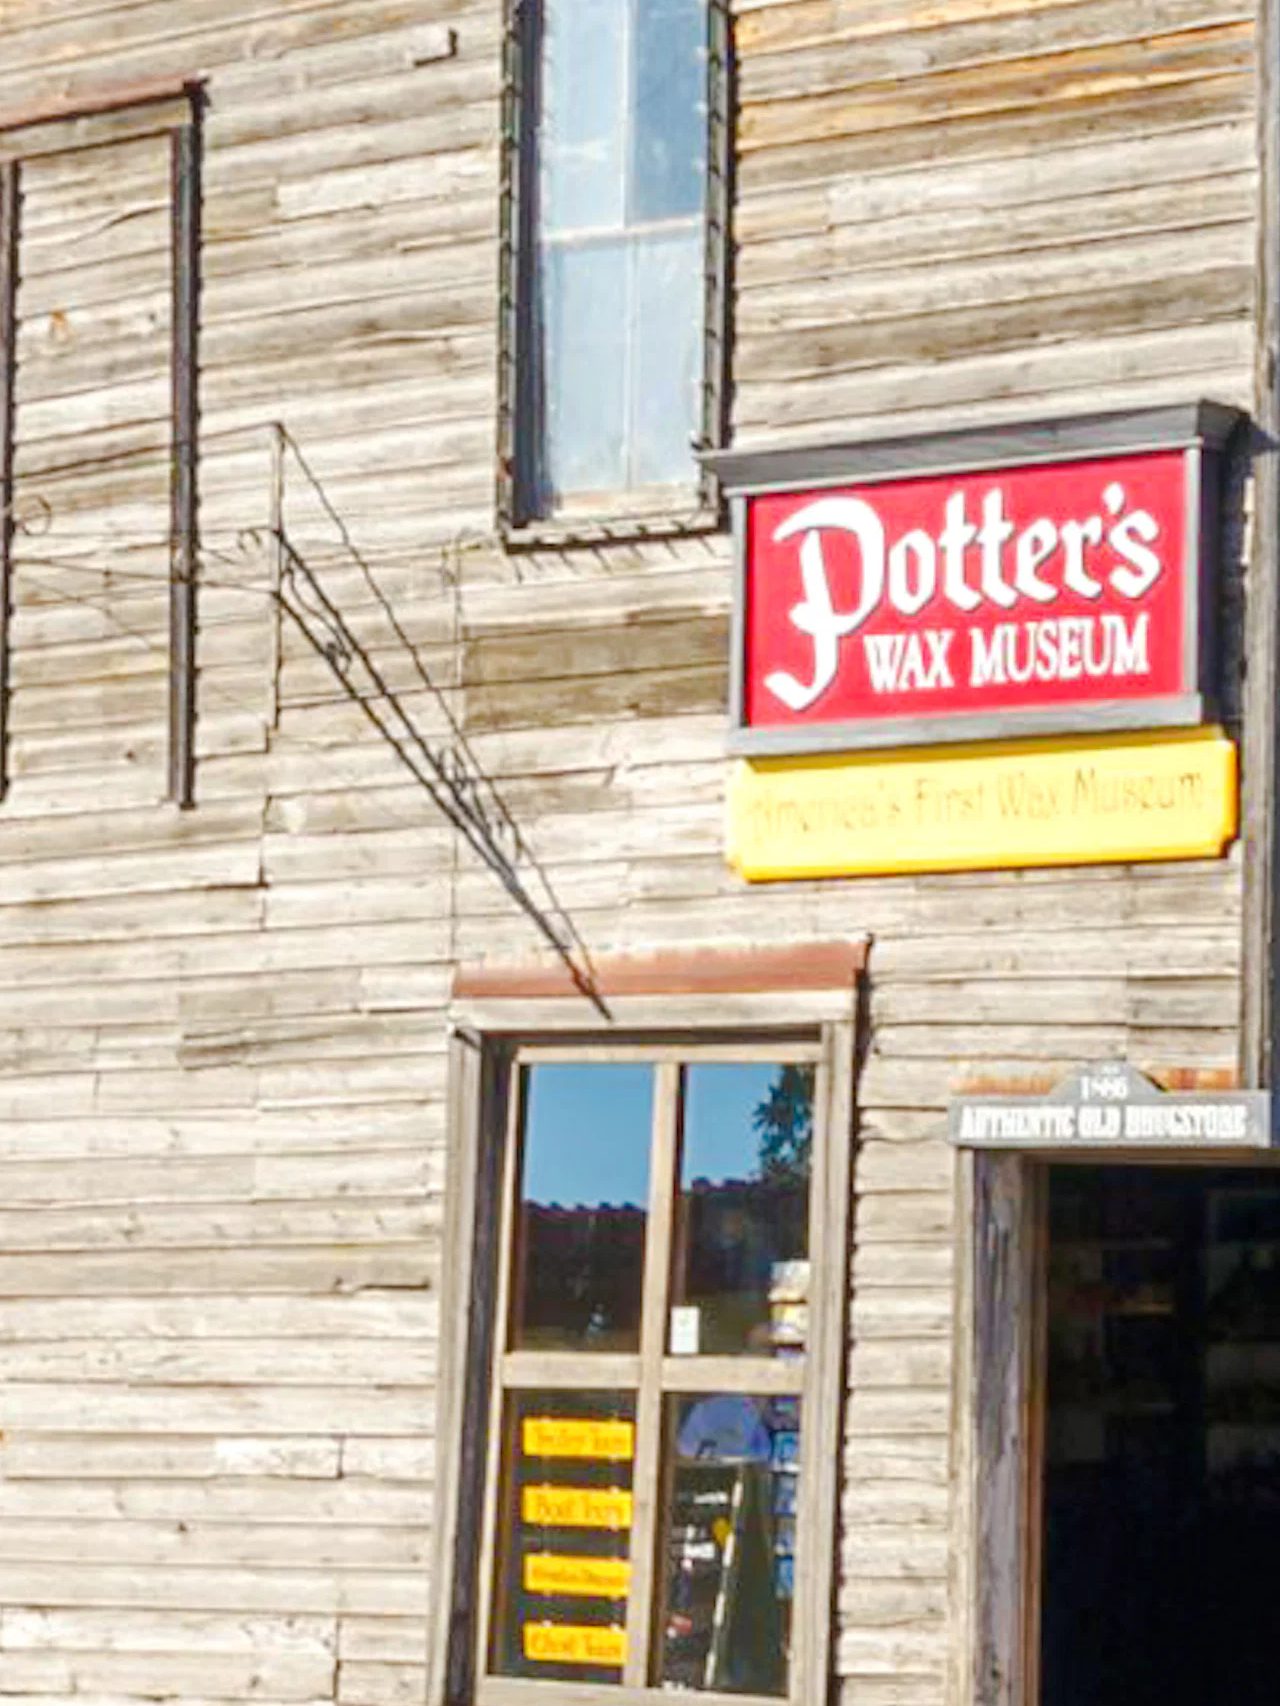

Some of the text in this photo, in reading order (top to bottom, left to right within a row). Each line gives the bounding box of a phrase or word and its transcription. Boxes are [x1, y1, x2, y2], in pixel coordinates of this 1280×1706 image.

[764, 482, 1164, 712] Potter's
[863, 612, 1150, 694] WAX MUSEUM
[914, 775, 985, 826] First
[998, 770, 1058, 822] Wax
[1071, 766, 1204, 816] Museum
[960, 1104, 1249, 1139] AUTHENTIC OLD DRUGSTORE
